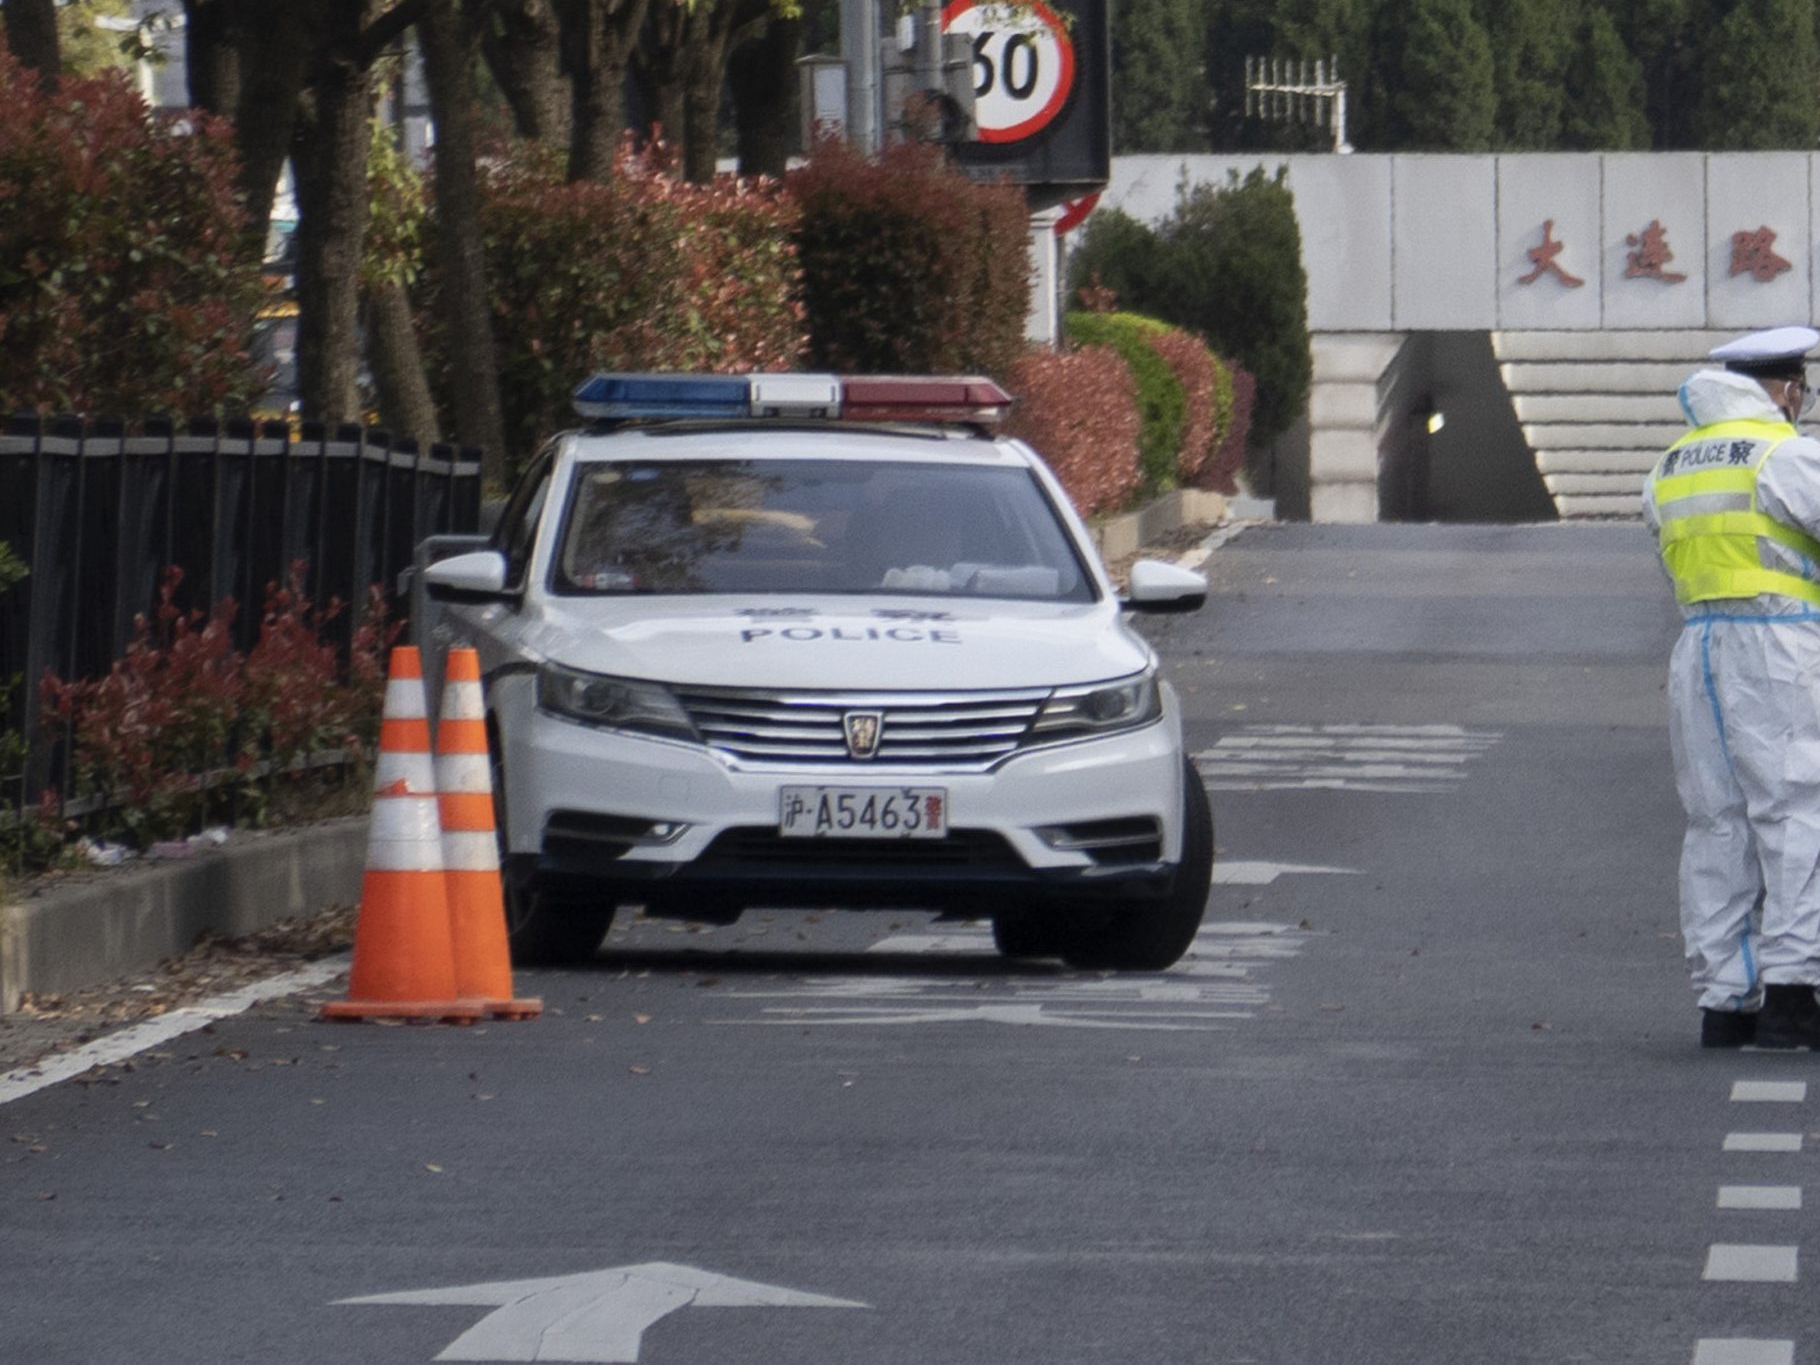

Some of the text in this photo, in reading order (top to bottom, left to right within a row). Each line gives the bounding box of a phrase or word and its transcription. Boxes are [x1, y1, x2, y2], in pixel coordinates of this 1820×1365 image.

[1680, 443, 1727, 469] POLICE
[1727, 439, 1757, 466] 察
[741, 627, 963, 645] POLICE
